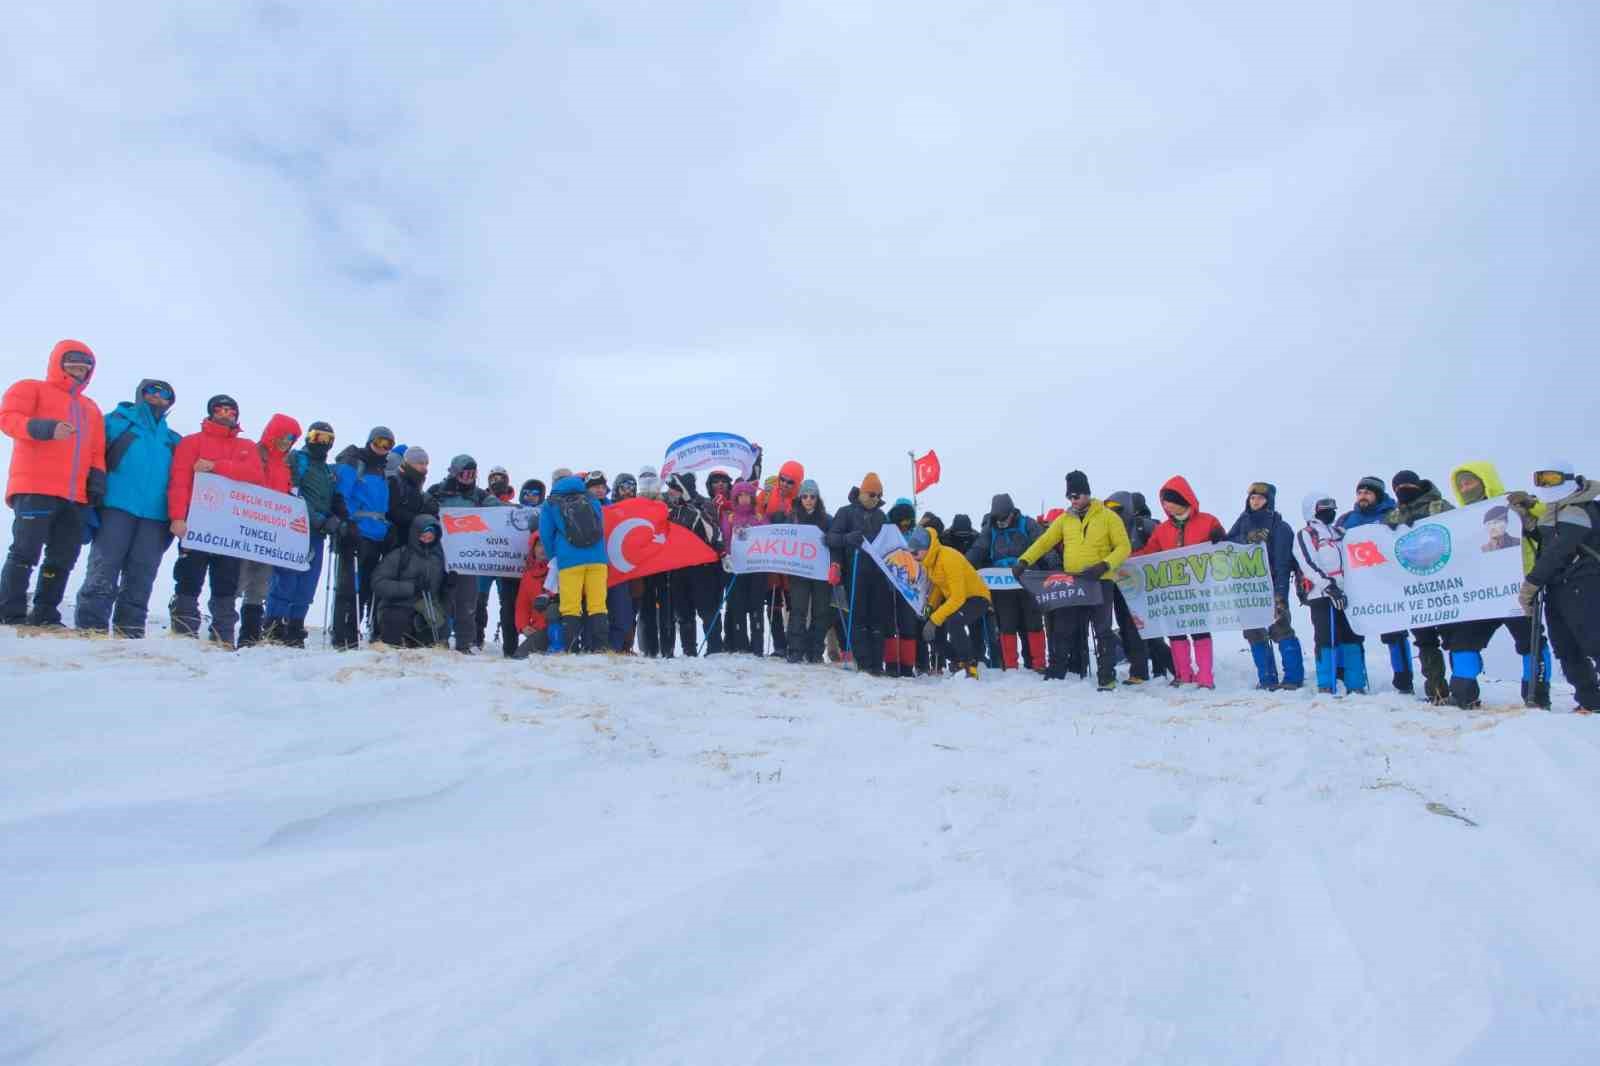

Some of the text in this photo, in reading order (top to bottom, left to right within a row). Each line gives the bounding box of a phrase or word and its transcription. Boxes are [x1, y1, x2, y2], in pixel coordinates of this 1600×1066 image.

[187, 531, 240, 549] DAĞCILIK
[240, 525, 278, 543] TUNCELİ
[747, 540, 817, 560] AKUD
[1143, 544, 1269, 592] MEVSİM
[1035, 588, 1086, 604] SHERPA
[1403, 576, 1464, 598] KAĞIZMAN
[1148, 606, 1177, 618] DOĞA
[1179, 602, 1232, 615] SPORLARI
[1352, 602, 1405, 617] DAĞCILIK
[1409, 599, 1424, 611] VE
[1427, 593, 1460, 609] DOĞA
[1411, 609, 1459, 625] KULÜBÜ
